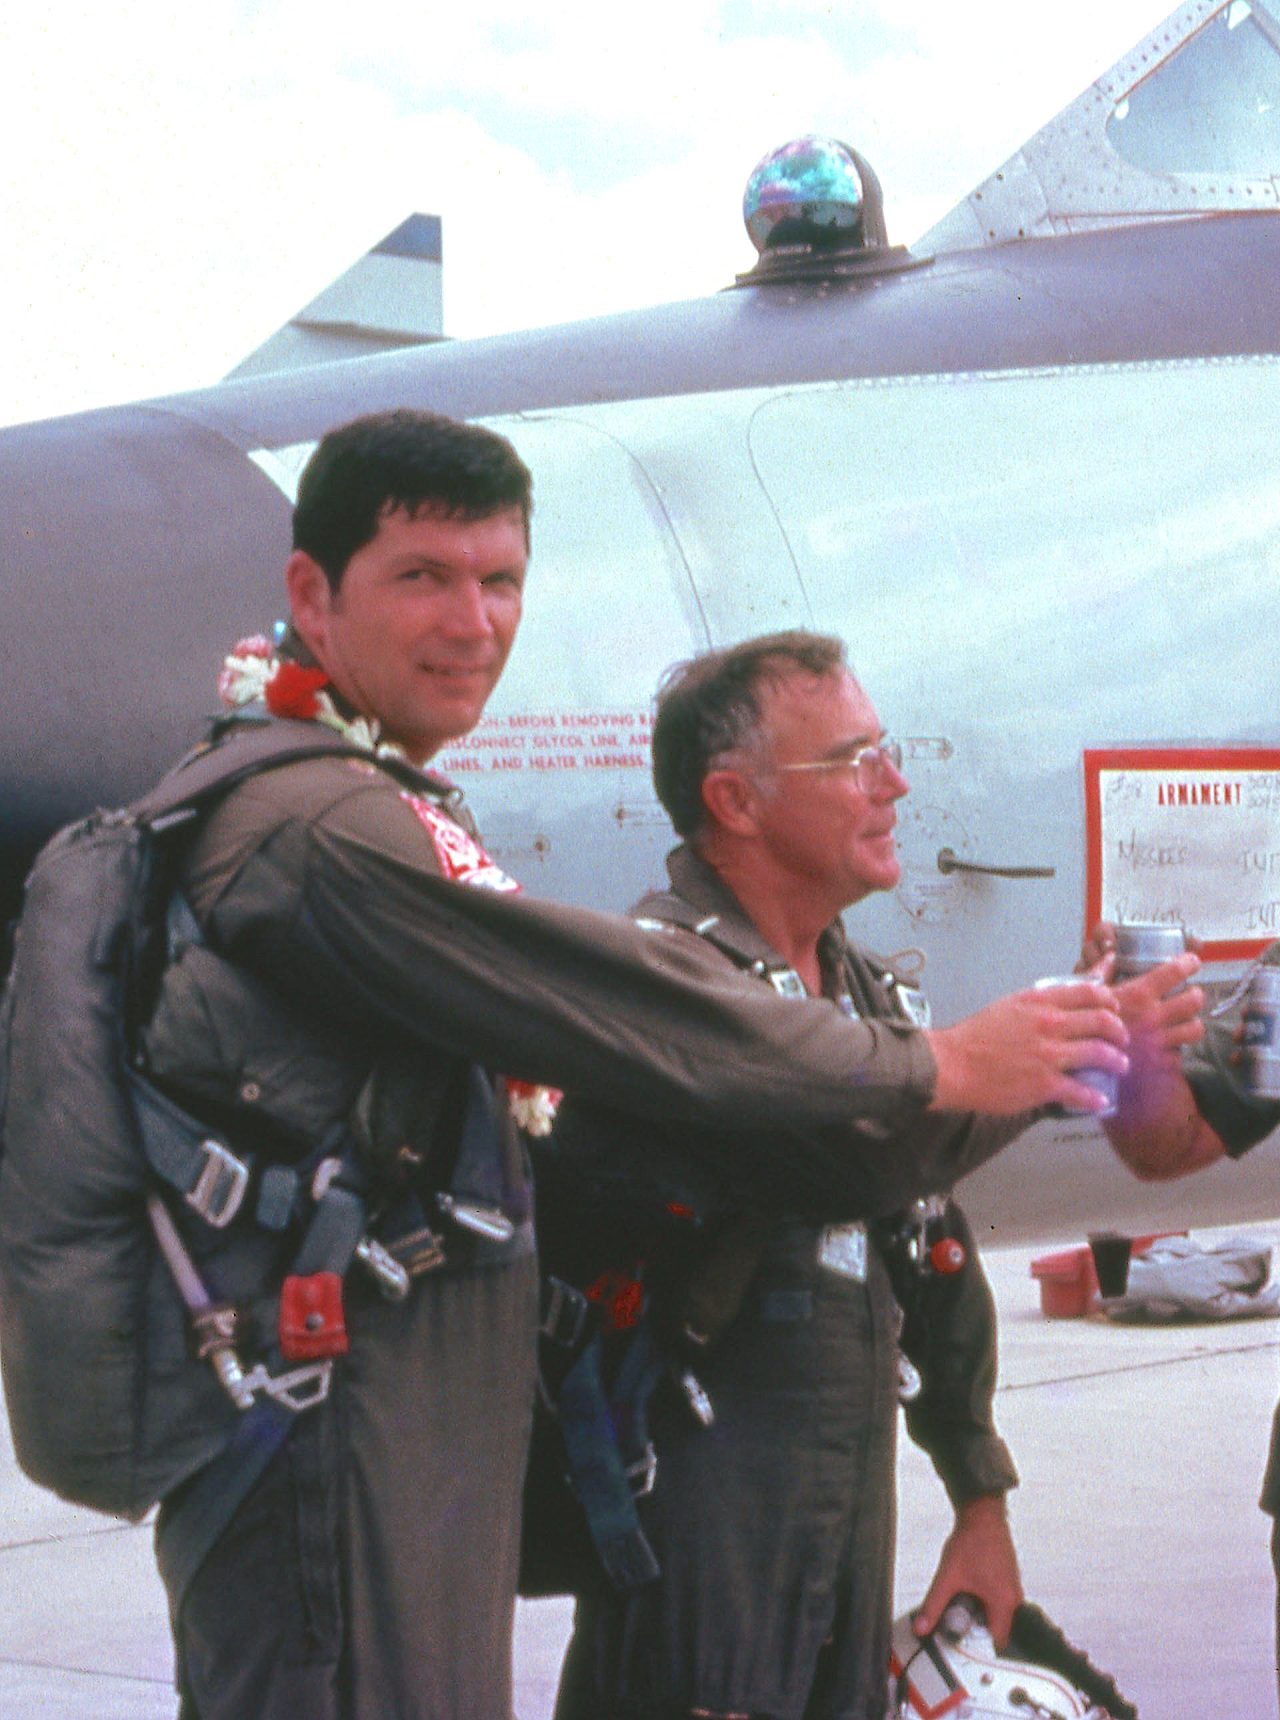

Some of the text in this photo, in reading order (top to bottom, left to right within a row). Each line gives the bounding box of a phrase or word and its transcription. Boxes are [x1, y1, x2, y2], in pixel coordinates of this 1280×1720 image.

[561, 714, 635, 727] REMOVING
[492, 757, 522, 769] AND
[1158, 783, 1241, 806] ARMAMENT
